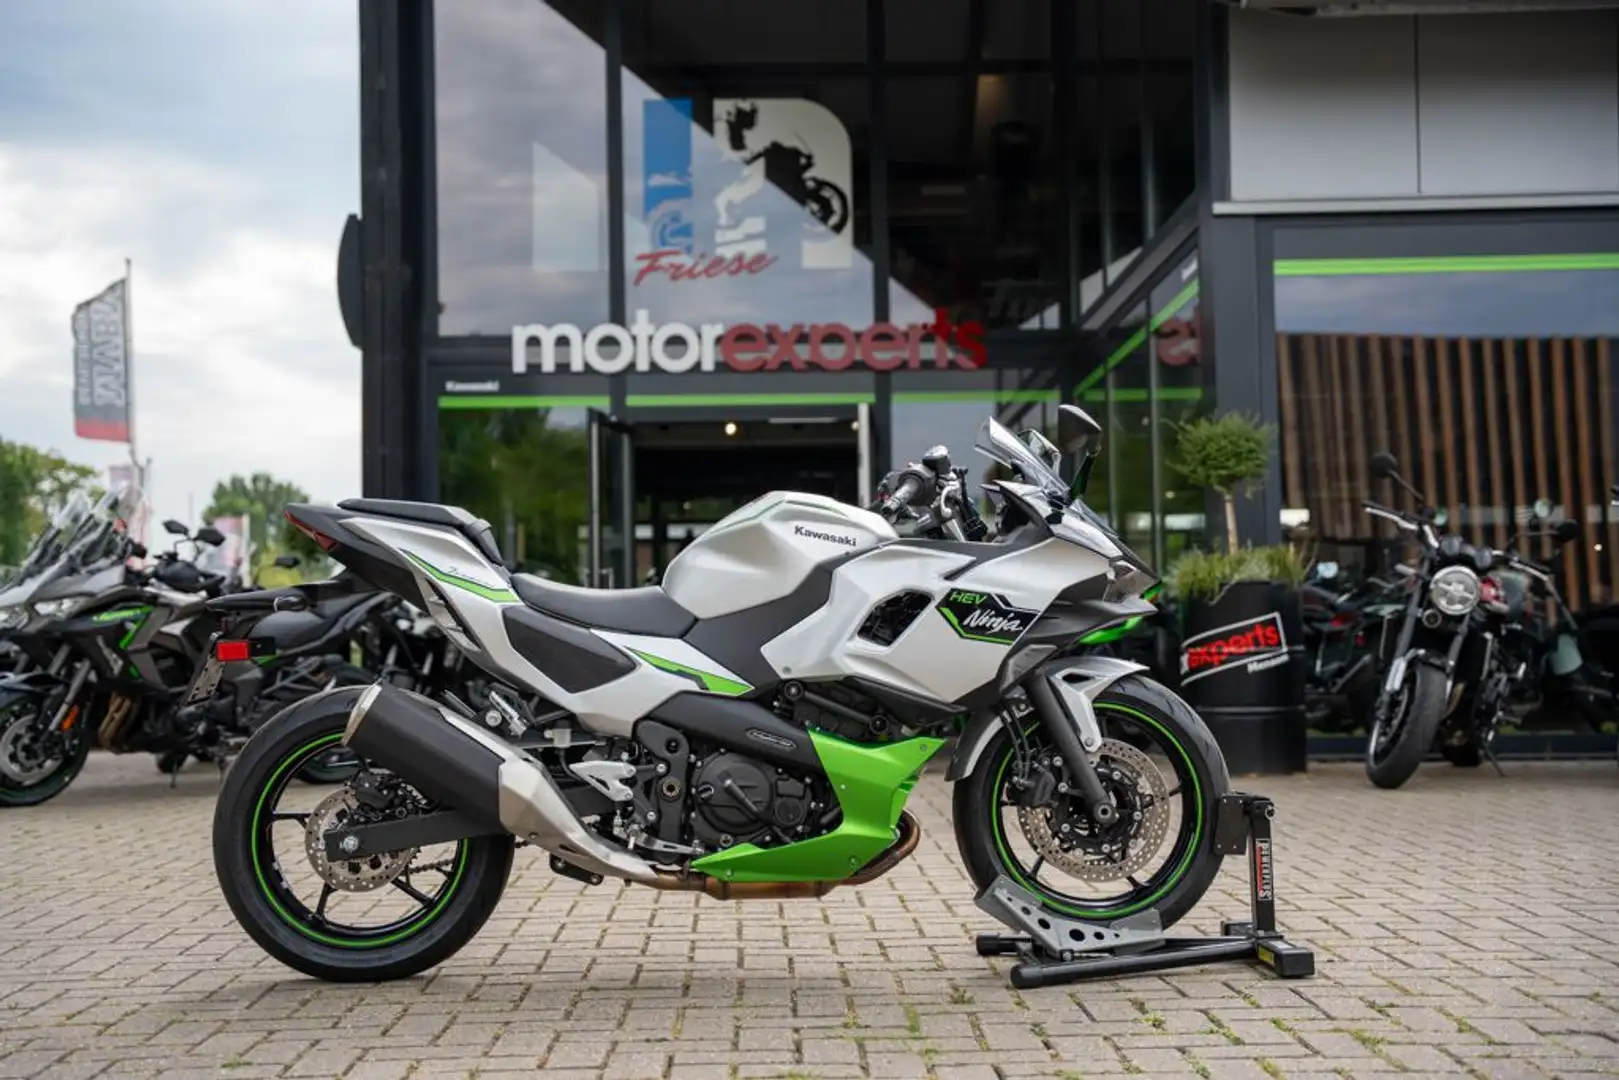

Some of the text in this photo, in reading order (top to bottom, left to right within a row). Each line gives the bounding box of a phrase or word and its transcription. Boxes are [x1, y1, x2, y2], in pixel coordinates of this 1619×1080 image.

[633, 249, 778, 286] Friese
[511, 307, 988, 373] motorexperts
[794, 525, 857, 546] Kawasaki
[950, 591, 987, 604] HEV
[963, 608, 1023, 634] Ninja
